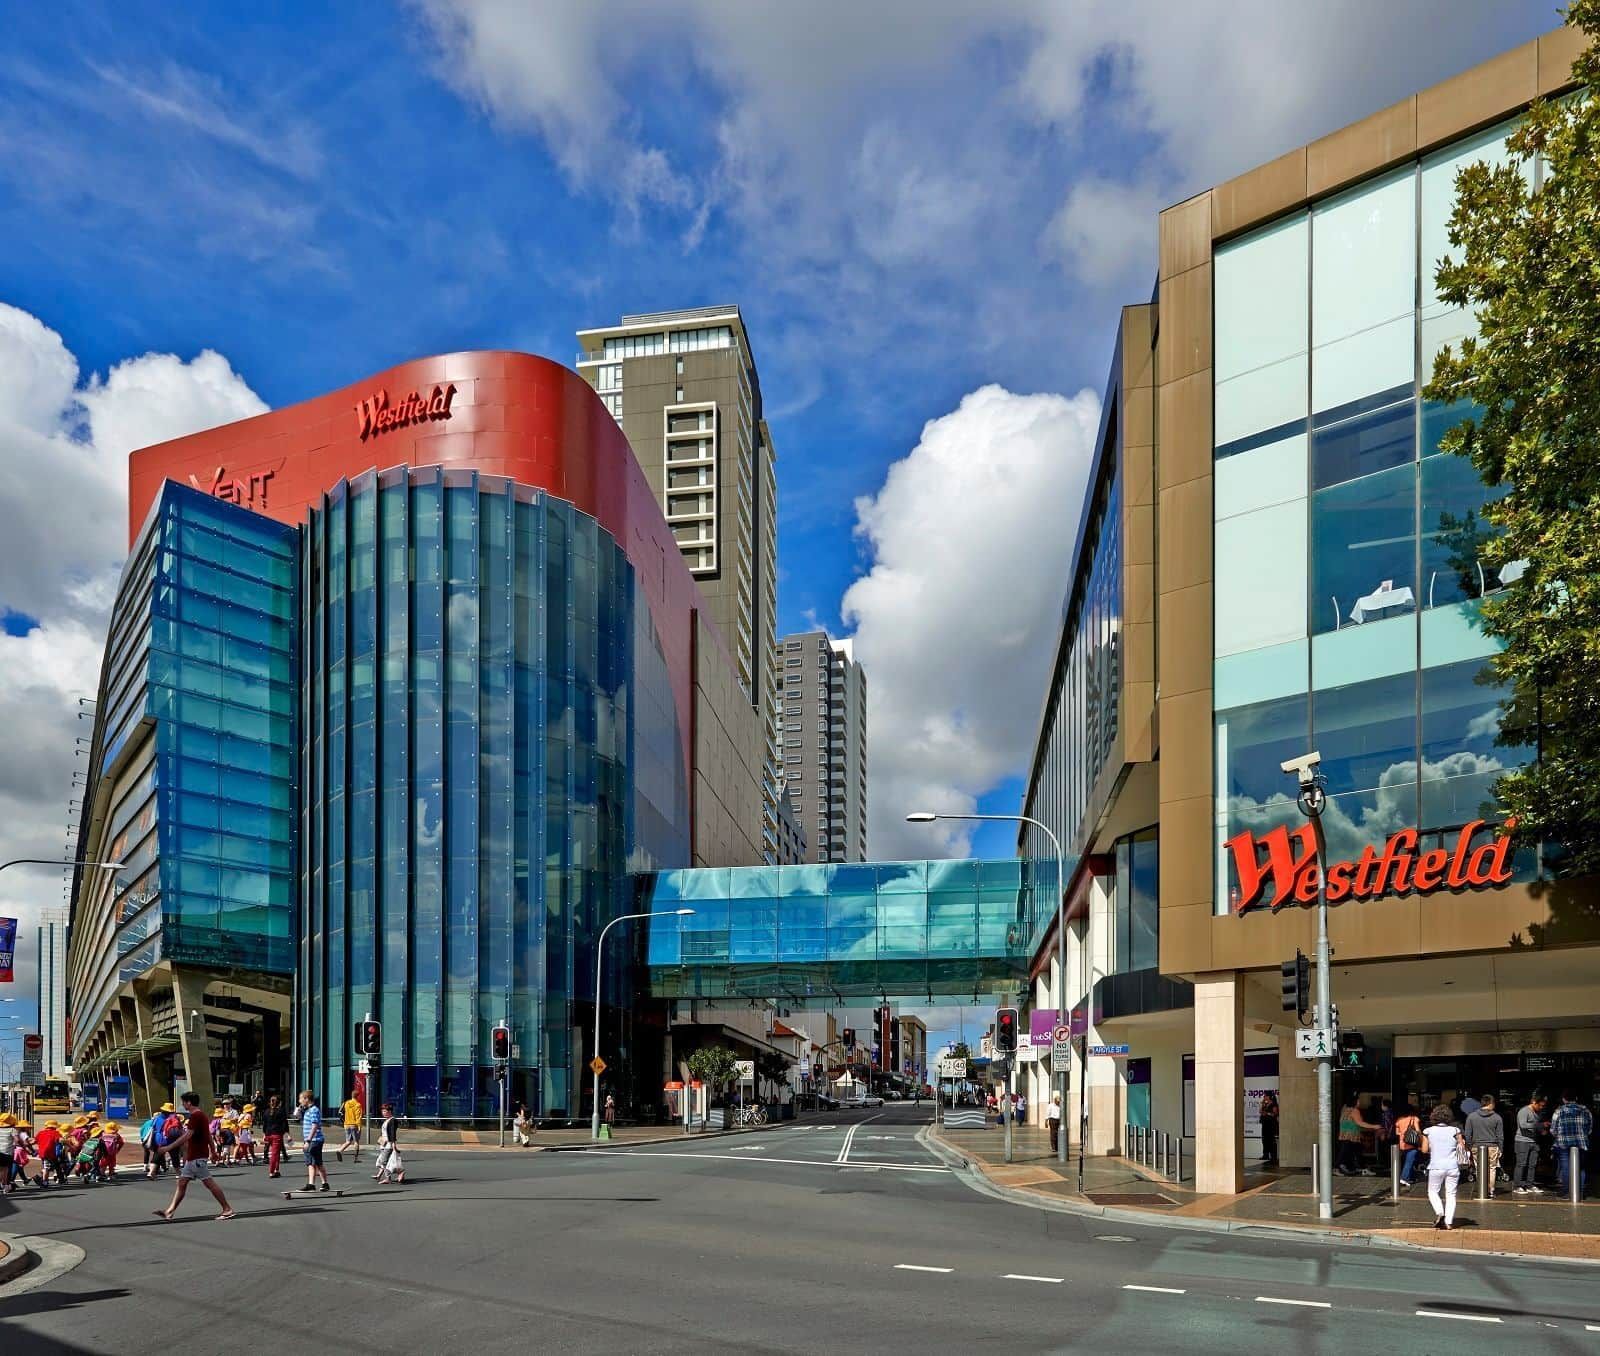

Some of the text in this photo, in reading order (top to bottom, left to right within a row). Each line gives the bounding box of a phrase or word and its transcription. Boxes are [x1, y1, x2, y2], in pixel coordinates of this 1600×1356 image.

[354, 385, 456, 441] Westfield
[1224, 815, 1517, 916] Westfield
[1095, 1046, 1123, 1054] ARGYLE ST
